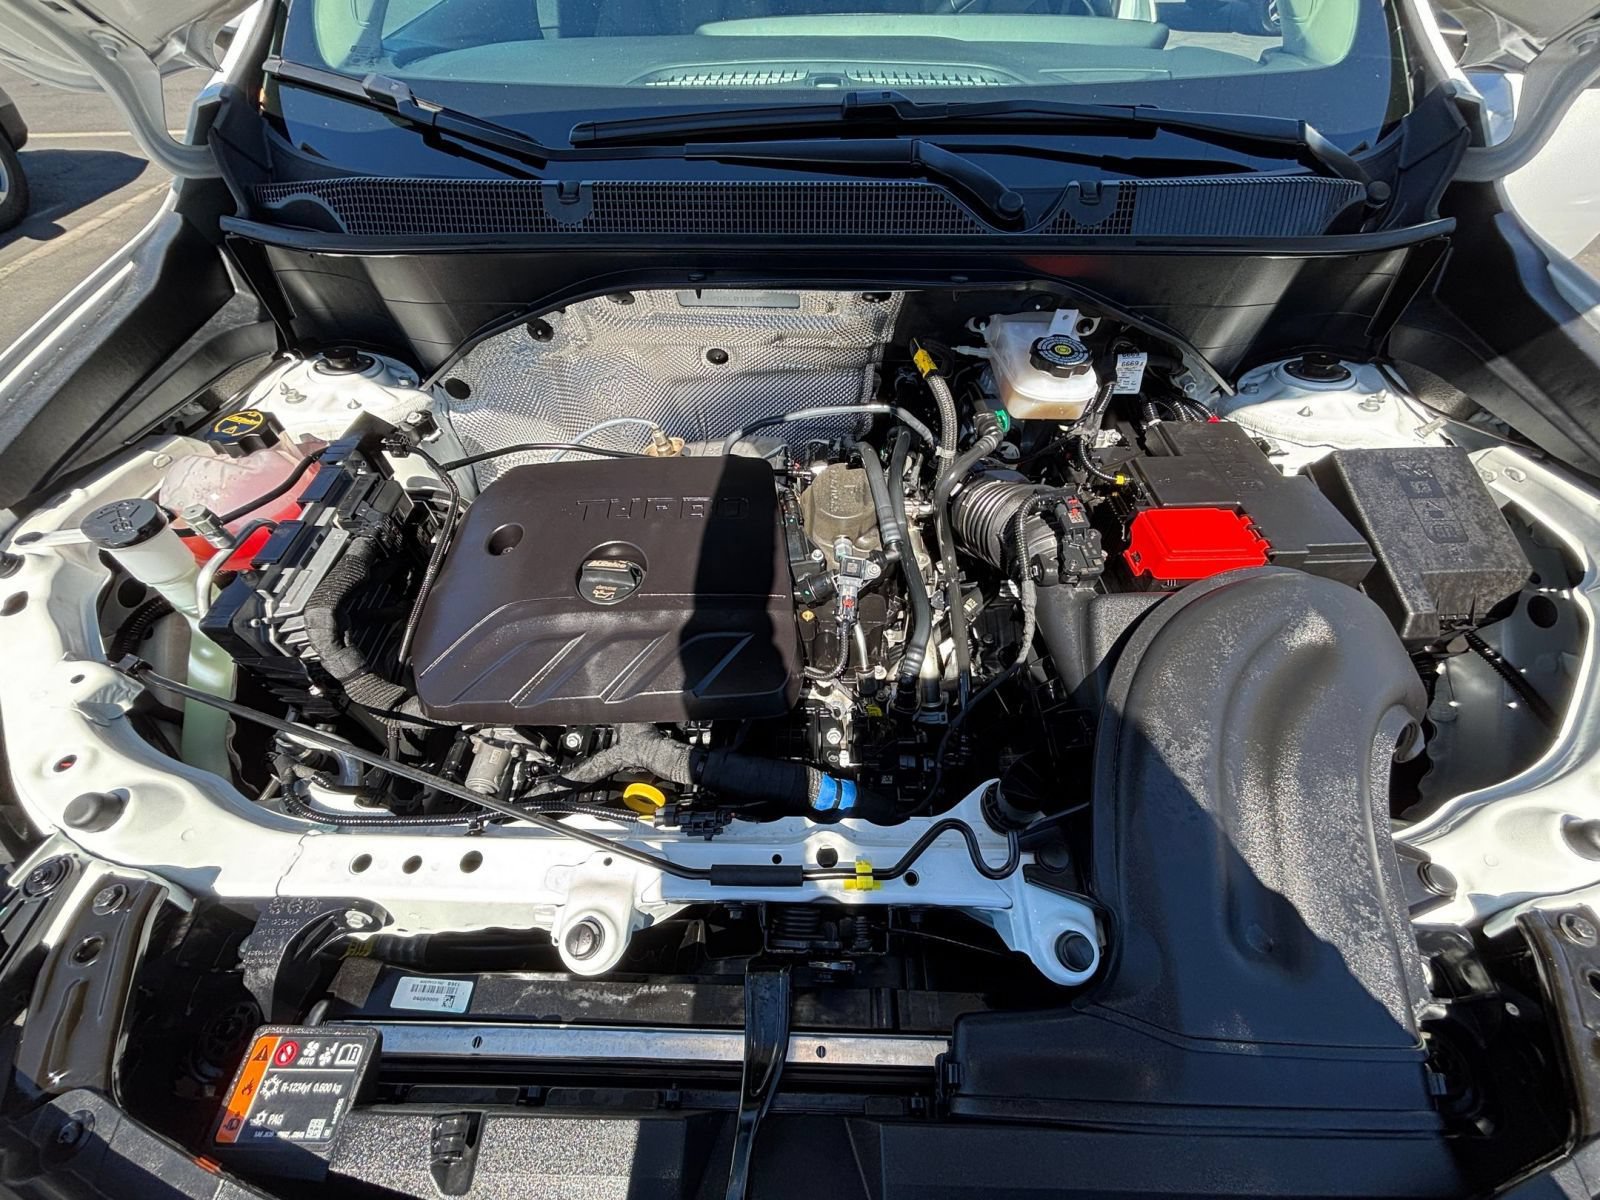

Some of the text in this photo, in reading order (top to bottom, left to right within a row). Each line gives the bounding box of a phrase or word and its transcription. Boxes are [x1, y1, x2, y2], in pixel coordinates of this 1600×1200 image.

[576, 496, 750, 521] TURBO
[297, 1057, 315, 1065] AUTO
[332, 1083, 343, 1094] kg
[267, 1112, 284, 1126] PAG
